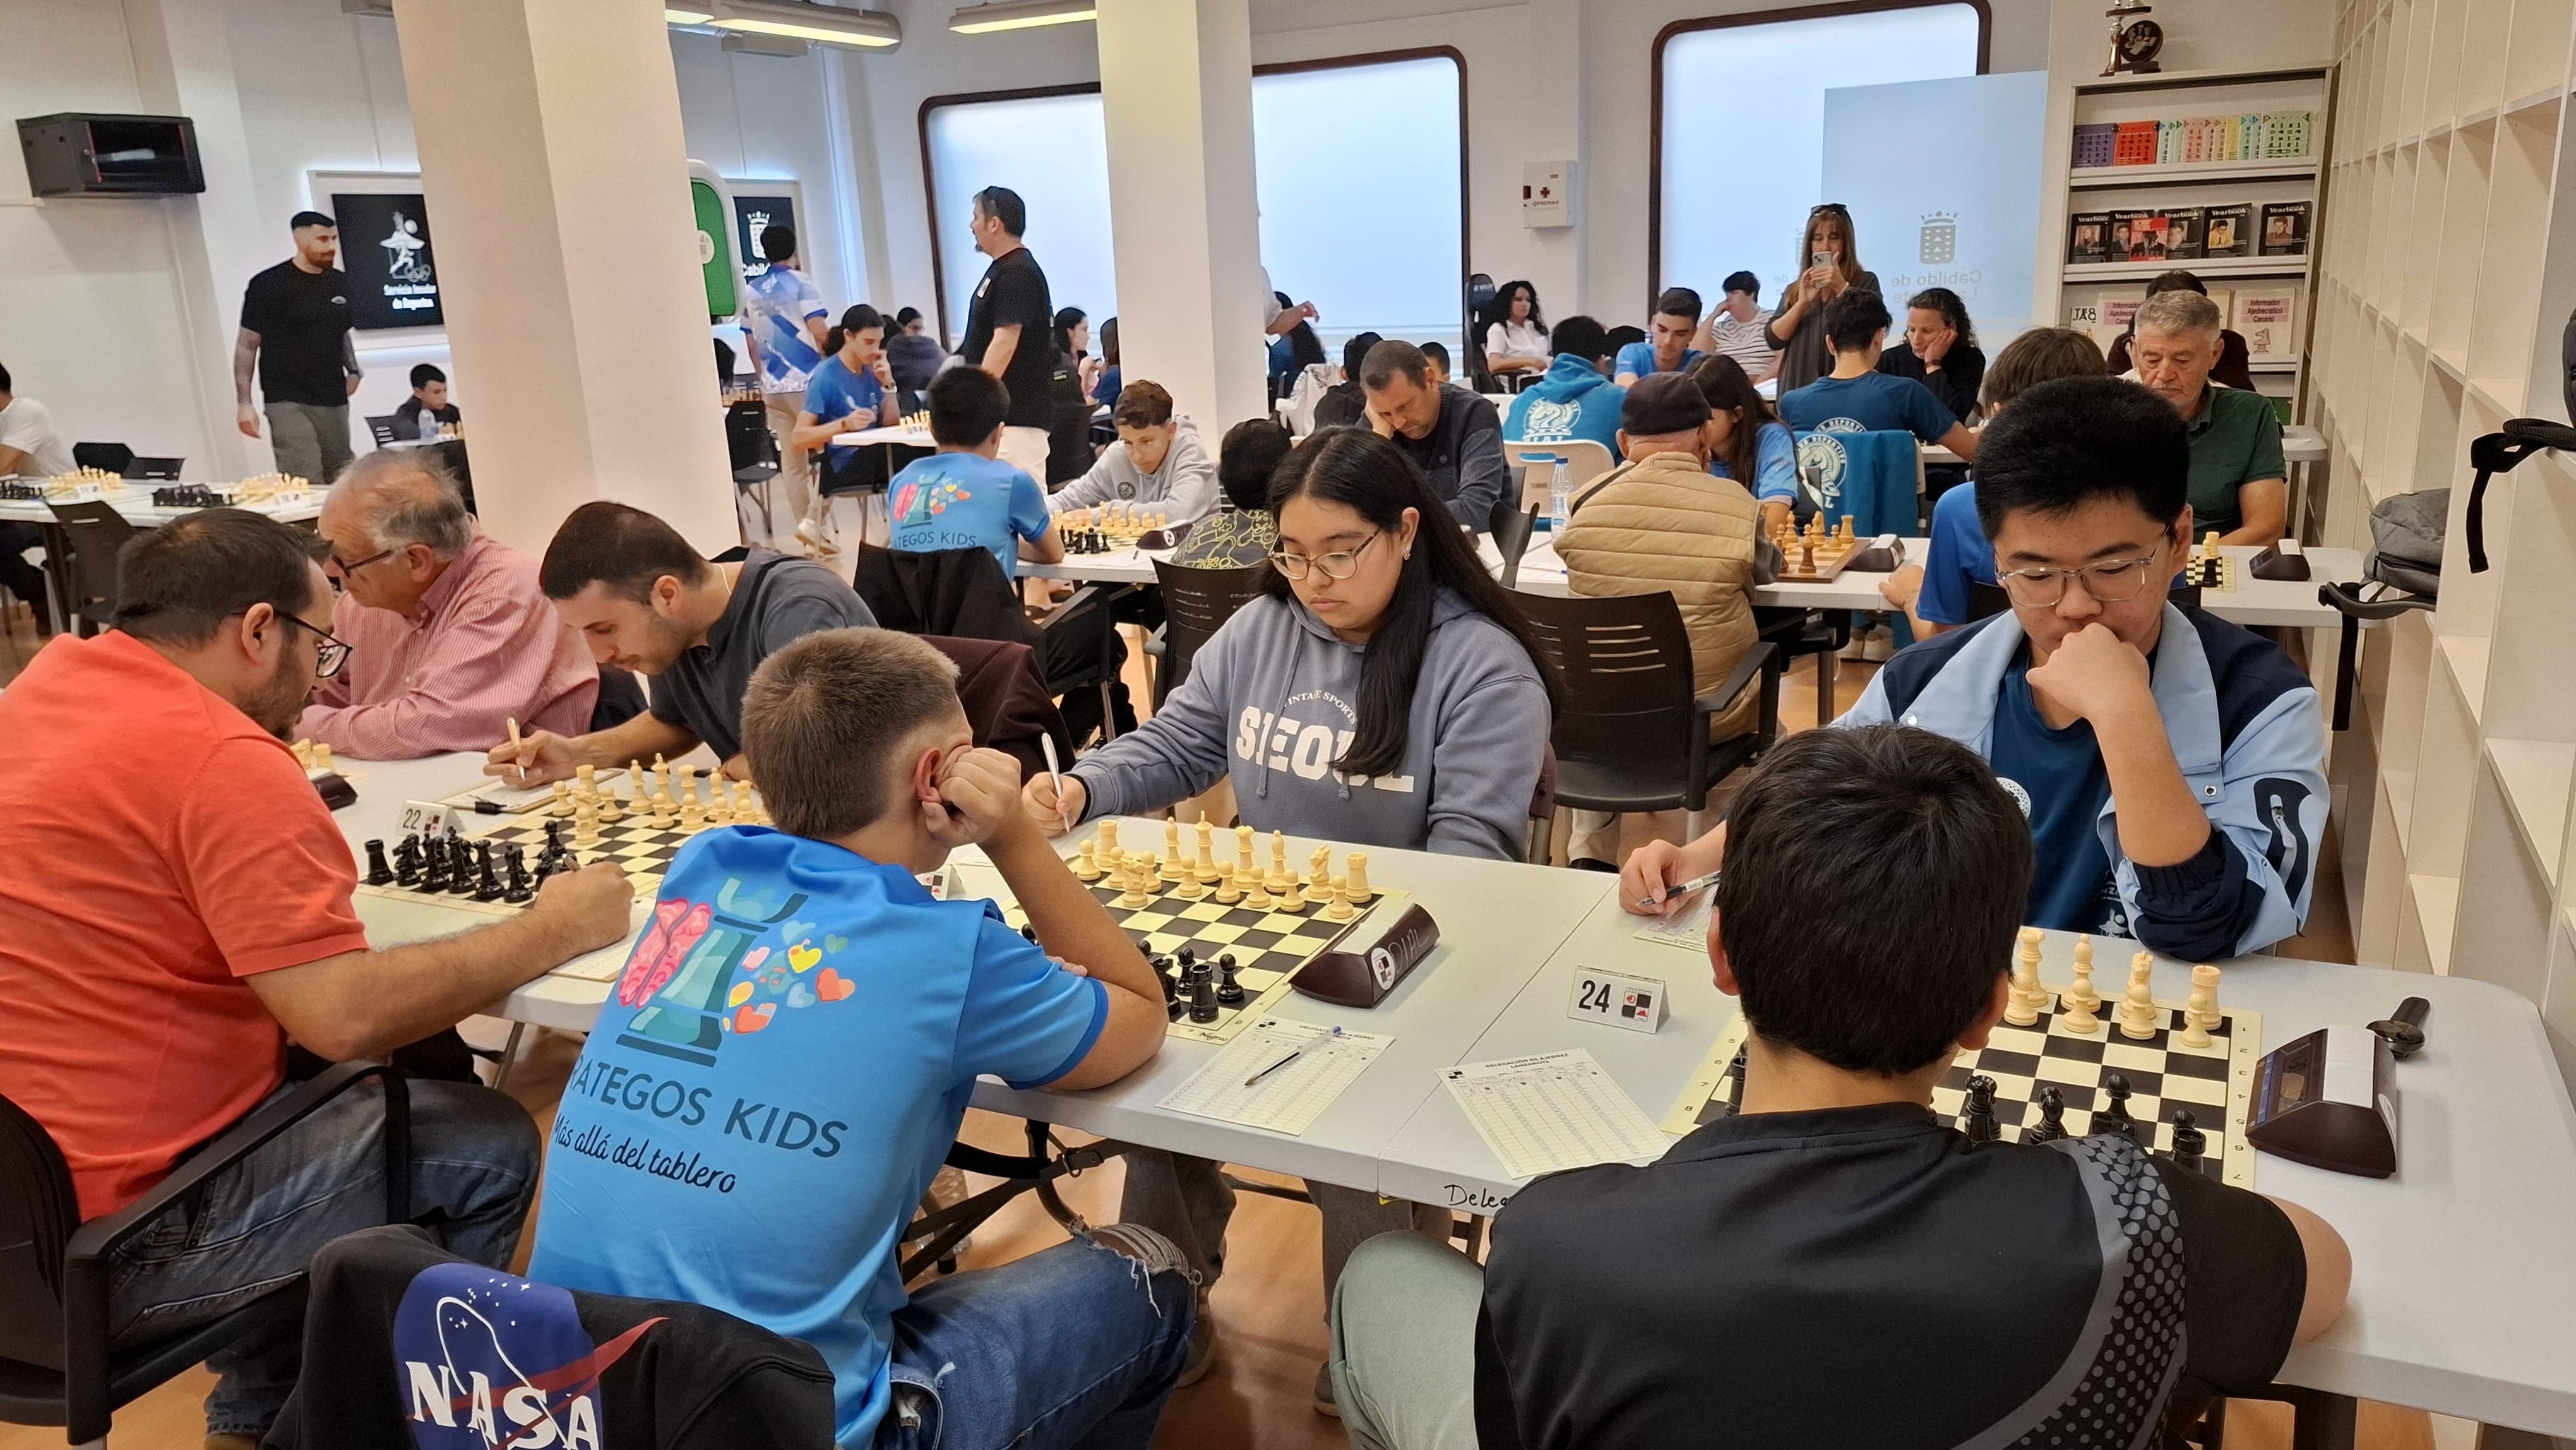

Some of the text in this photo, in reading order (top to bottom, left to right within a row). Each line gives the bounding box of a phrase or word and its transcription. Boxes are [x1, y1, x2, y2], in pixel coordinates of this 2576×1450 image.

[2164, 210, 2199, 218] Yearbook
[2212, 208, 2247, 216] Yearbook
[742, 263, 771, 277] Cabil
[940, 531, 977, 547] KIDS
[1285, 690, 1357, 724] INTAE SPORTS
[402, 808, 421, 830] 22
[1578, 980, 1611, 1013] 24
[1485, 1059, 1529, 1068] DELEGACIÓN
[1540, 1053, 1570, 1061] AJEDREZ
[1510, 1060, 1550, 1069] LANZAROTE
[724, 1098, 849, 1158] KIDS
[574, 1123, 609, 1159] allá
[612, 1136, 649, 1170] del
[648, 1148, 736, 1194] tablero
[405, 1361, 599, 1450] NASA
